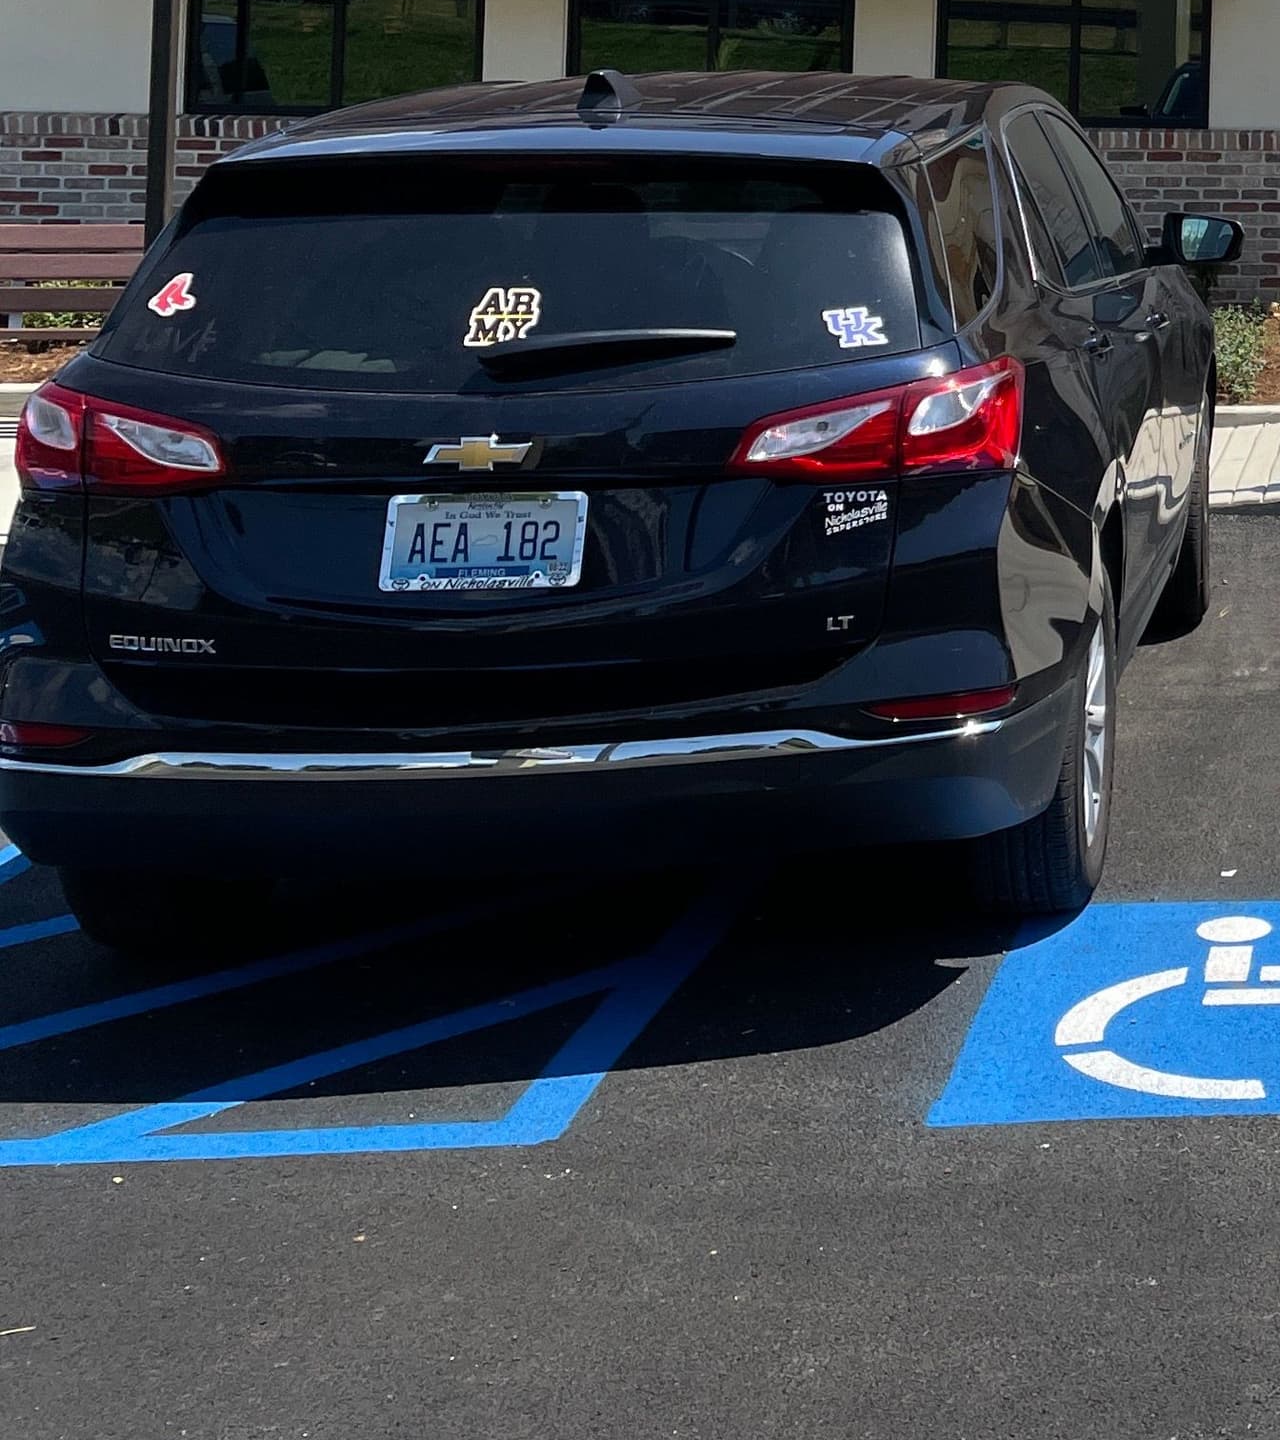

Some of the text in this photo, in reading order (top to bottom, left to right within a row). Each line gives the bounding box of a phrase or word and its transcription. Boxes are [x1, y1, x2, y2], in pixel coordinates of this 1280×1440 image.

[825, 309, 884, 346] UK
[823, 490, 888, 503] TOYOTA
[825, 501, 888, 528] Nicholasville
[827, 503, 844, 512] ON
[445, 511, 531, 520] In God We Trust
[408, 521, 560, 563] AEA 182
[458, 568, 506, 577] FLEMING
[444, 576, 534, 590] Nicholasville
[827, 615, 855, 631] LT
[109, 634, 217, 654] EQUINOX
